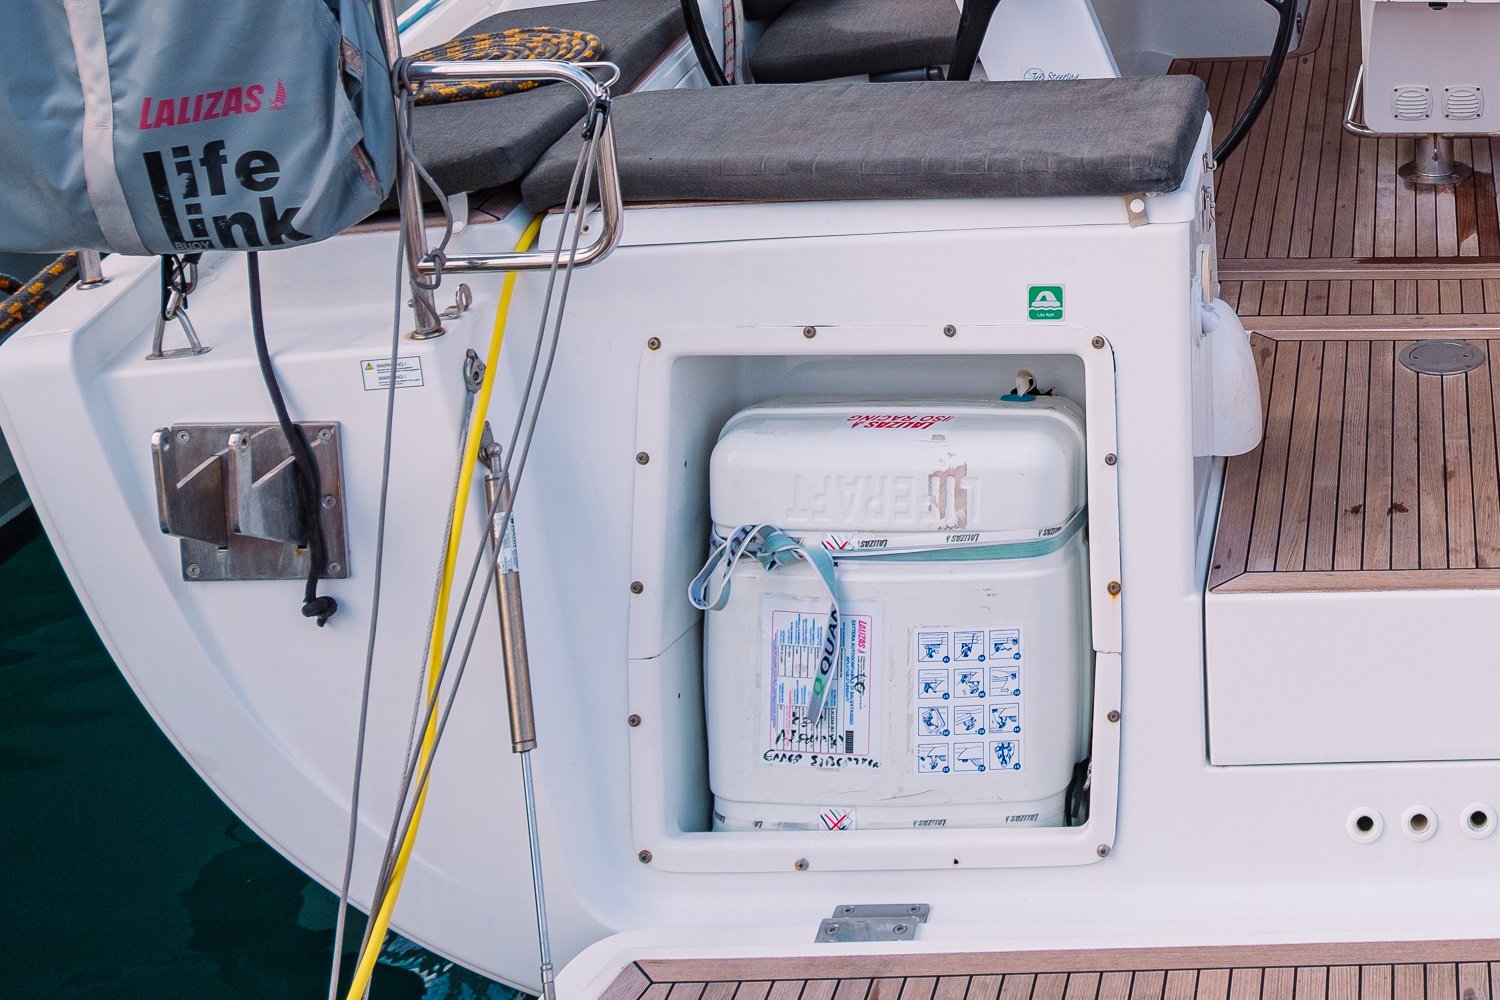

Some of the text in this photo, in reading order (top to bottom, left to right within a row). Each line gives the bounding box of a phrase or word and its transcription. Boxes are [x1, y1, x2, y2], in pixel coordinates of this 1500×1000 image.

[138, 83, 265, 131] LALIZAS
[142, 139, 281, 196] life
[864, 421, 936, 430] LALIZAS
[860, 539, 888, 548] LALIZAS
[951, 533, 981, 543] LALIZAS
[858, 620, 867, 649] LALIZAS
